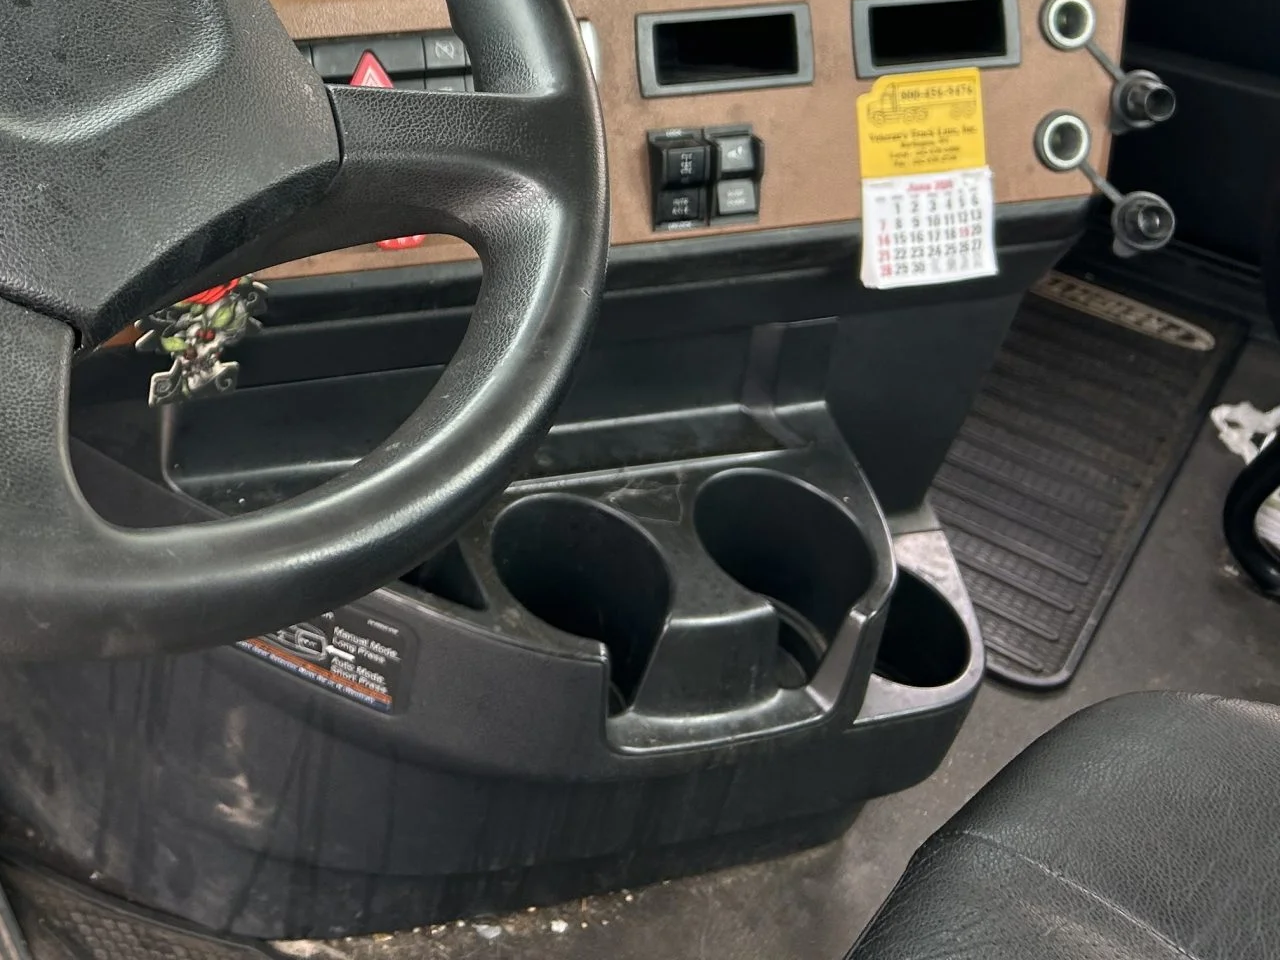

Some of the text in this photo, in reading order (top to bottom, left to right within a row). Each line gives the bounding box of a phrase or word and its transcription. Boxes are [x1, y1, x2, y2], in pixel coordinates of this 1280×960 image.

[895, 202, 900, 214] 1
[911, 200, 919, 213] 2
[930, 199, 937, 212] 3
[946, 198, 952, 210] 4
[959, 196, 965, 207] 5
[972, 194, 979, 206] 6
[895, 218, 902, 229] 8
[912, 216, 920, 228] 9
[927, 214, 940, 226] 10
[944, 213, 955, 225] 11
[958, 211, 968, 223] 12
[971, 209, 982, 220] 13
[878, 234, 890, 246] 14
[893, 232, 906, 244] 15
[910, 230, 924, 242] 16
[927, 229, 940, 241] 17
[944, 227, 956, 238] 18
[971, 224, 982, 235] 20
[878, 239, 981, 262] 21 22 23 24 25 26 27
[895, 262, 908, 275] 29
[911, 261, 925, 273] 30
[334, 626, 370, 646] Manual
